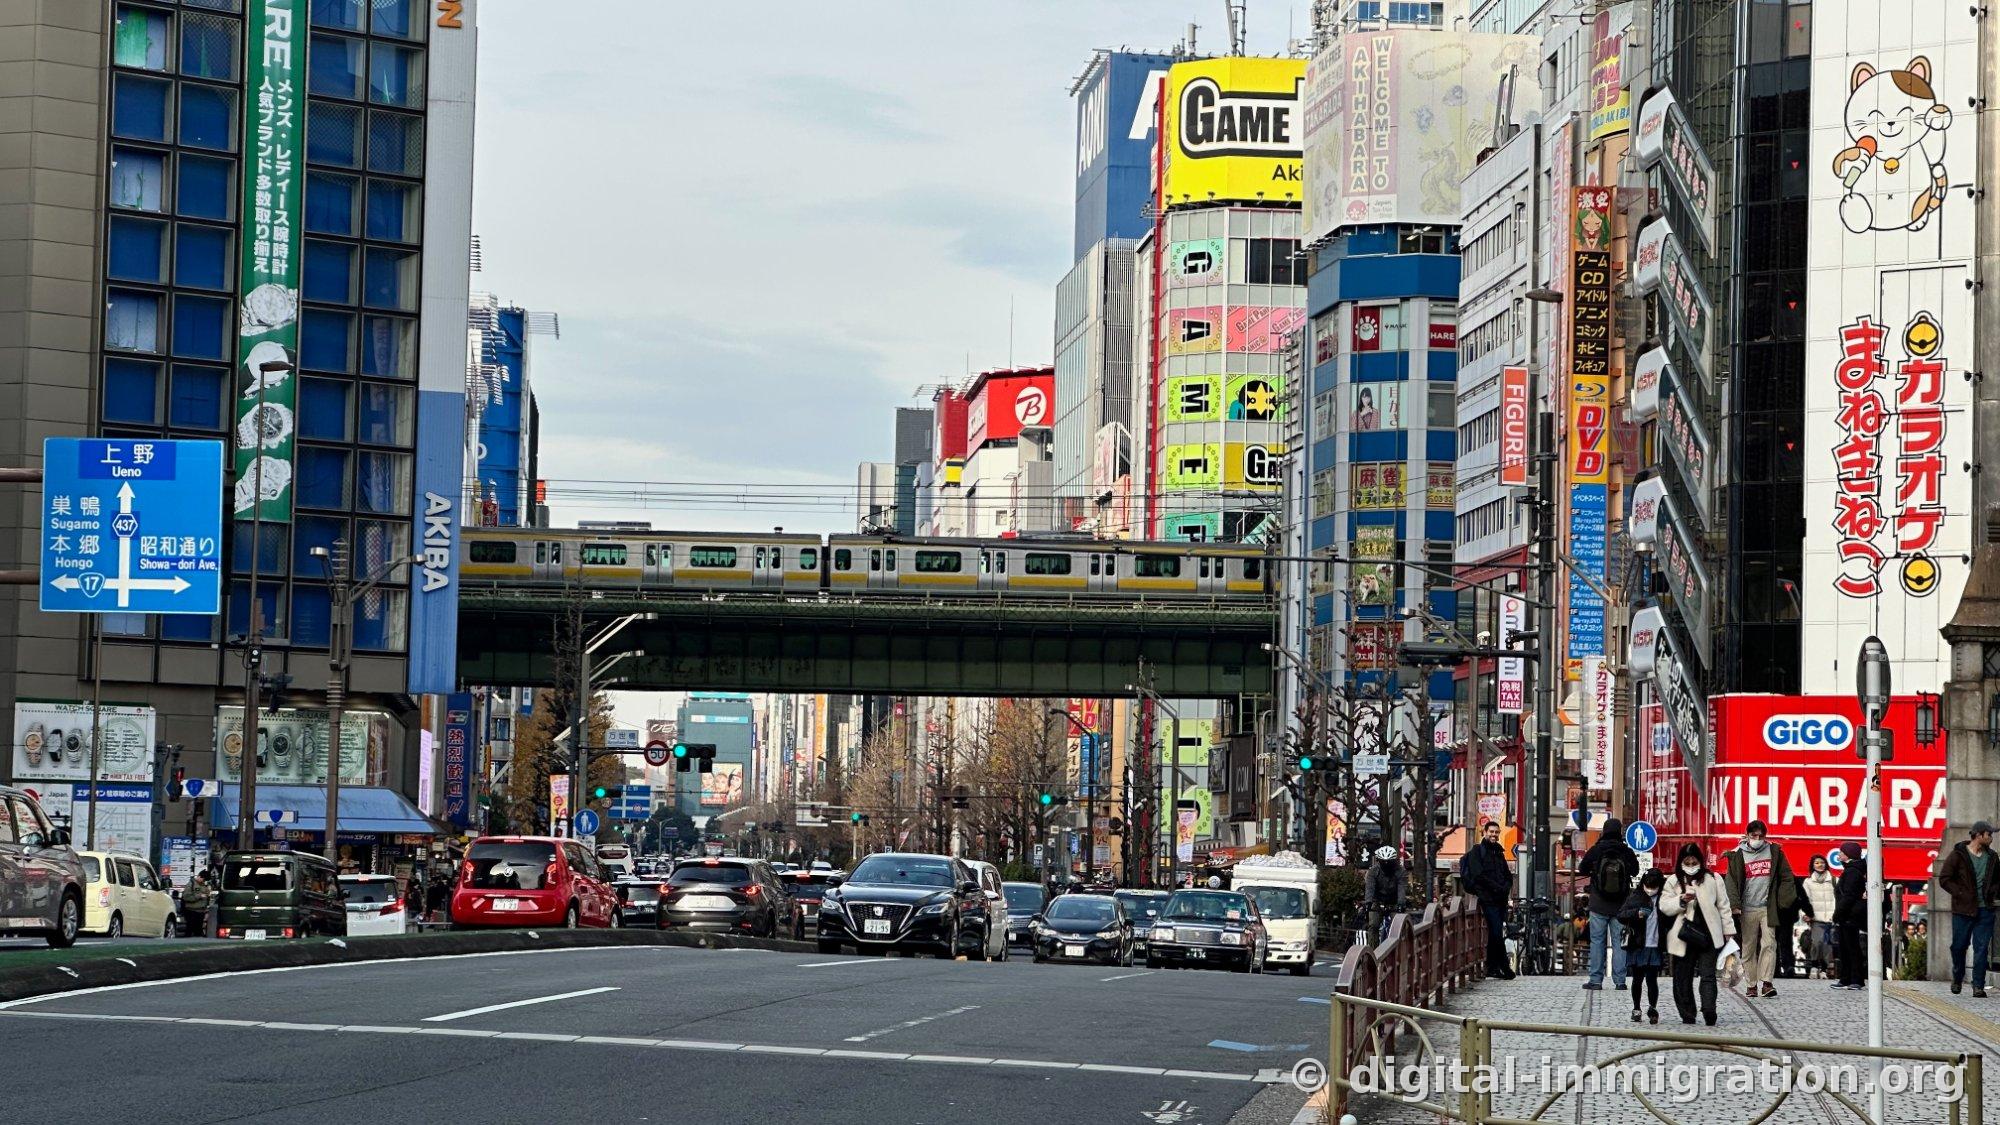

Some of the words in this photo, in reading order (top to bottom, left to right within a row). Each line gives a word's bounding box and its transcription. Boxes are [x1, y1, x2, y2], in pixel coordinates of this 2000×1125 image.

[437, 0, 463, 29] N
[262, 0, 292, 70] RE
[1374, 38, 1393, 149] WELCOME
[1185, 85, 1290, 145] GAME
[1351, 48, 1368, 192] AKIHABARA
[1078, 75, 1104, 177] AOKI
[253, 76, 273, 273] 人気ブランド多数取り揃え
[270, 80, 293, 275] メンズ・レディース腕時計
[1373, 157, 1389, 189] TO
[1577, 255, 1608, 268] ゲーム
[1580, 271, 1605, 285] CD
[1576, 290, 1608, 302] アイドル
[1575, 307, 1608, 320] アニメ
[1430, 331, 1456, 341] HARE
[1576, 325, 1606, 337] コミック
[1577, 342, 1605, 355] ホビー
[1575, 360, 1606, 372] フィギュア
[1504, 383, 1525, 467] FIGURE
[1576, 404, 1606, 476] DVD
[101, 443, 154, 465] 上野
[1834, 317, 1889, 597] まねきねこ
[1896, 357, 1945, 552] カラオケ
[112, 466, 142, 477] Ueno
[51, 495, 101, 516] 巣鴨
[51, 518, 100, 531] Sugamo
[116, 520, 135, 532] 437
[50, 534, 100, 556] 本郷
[140, 536, 215, 558] 昭和通り
[421, 491, 452, 593] AKIBA
[55, 557, 94, 570] Hongo
[140, 558, 196, 570] Showa-dori
[198, 558, 218, 570] Ave.
[84, 576, 98, 591] 17
[1501, 682, 1521, 692] 免税
[1501, 692, 1521, 700] TAX
[1597, 671, 1608, 713] カラオケ
[262, 711, 293, 719] WATCH
[1500, 701, 1520, 709] FREE
[1435, 731, 1447, 744] 3F
[1767, 719, 1850, 746] GiGO
[1596, 725, 1608, 784] まねきねこ
[1710, 775, 1947, 830] AKIHABARA
[1035, 845, 1043, 855] P
